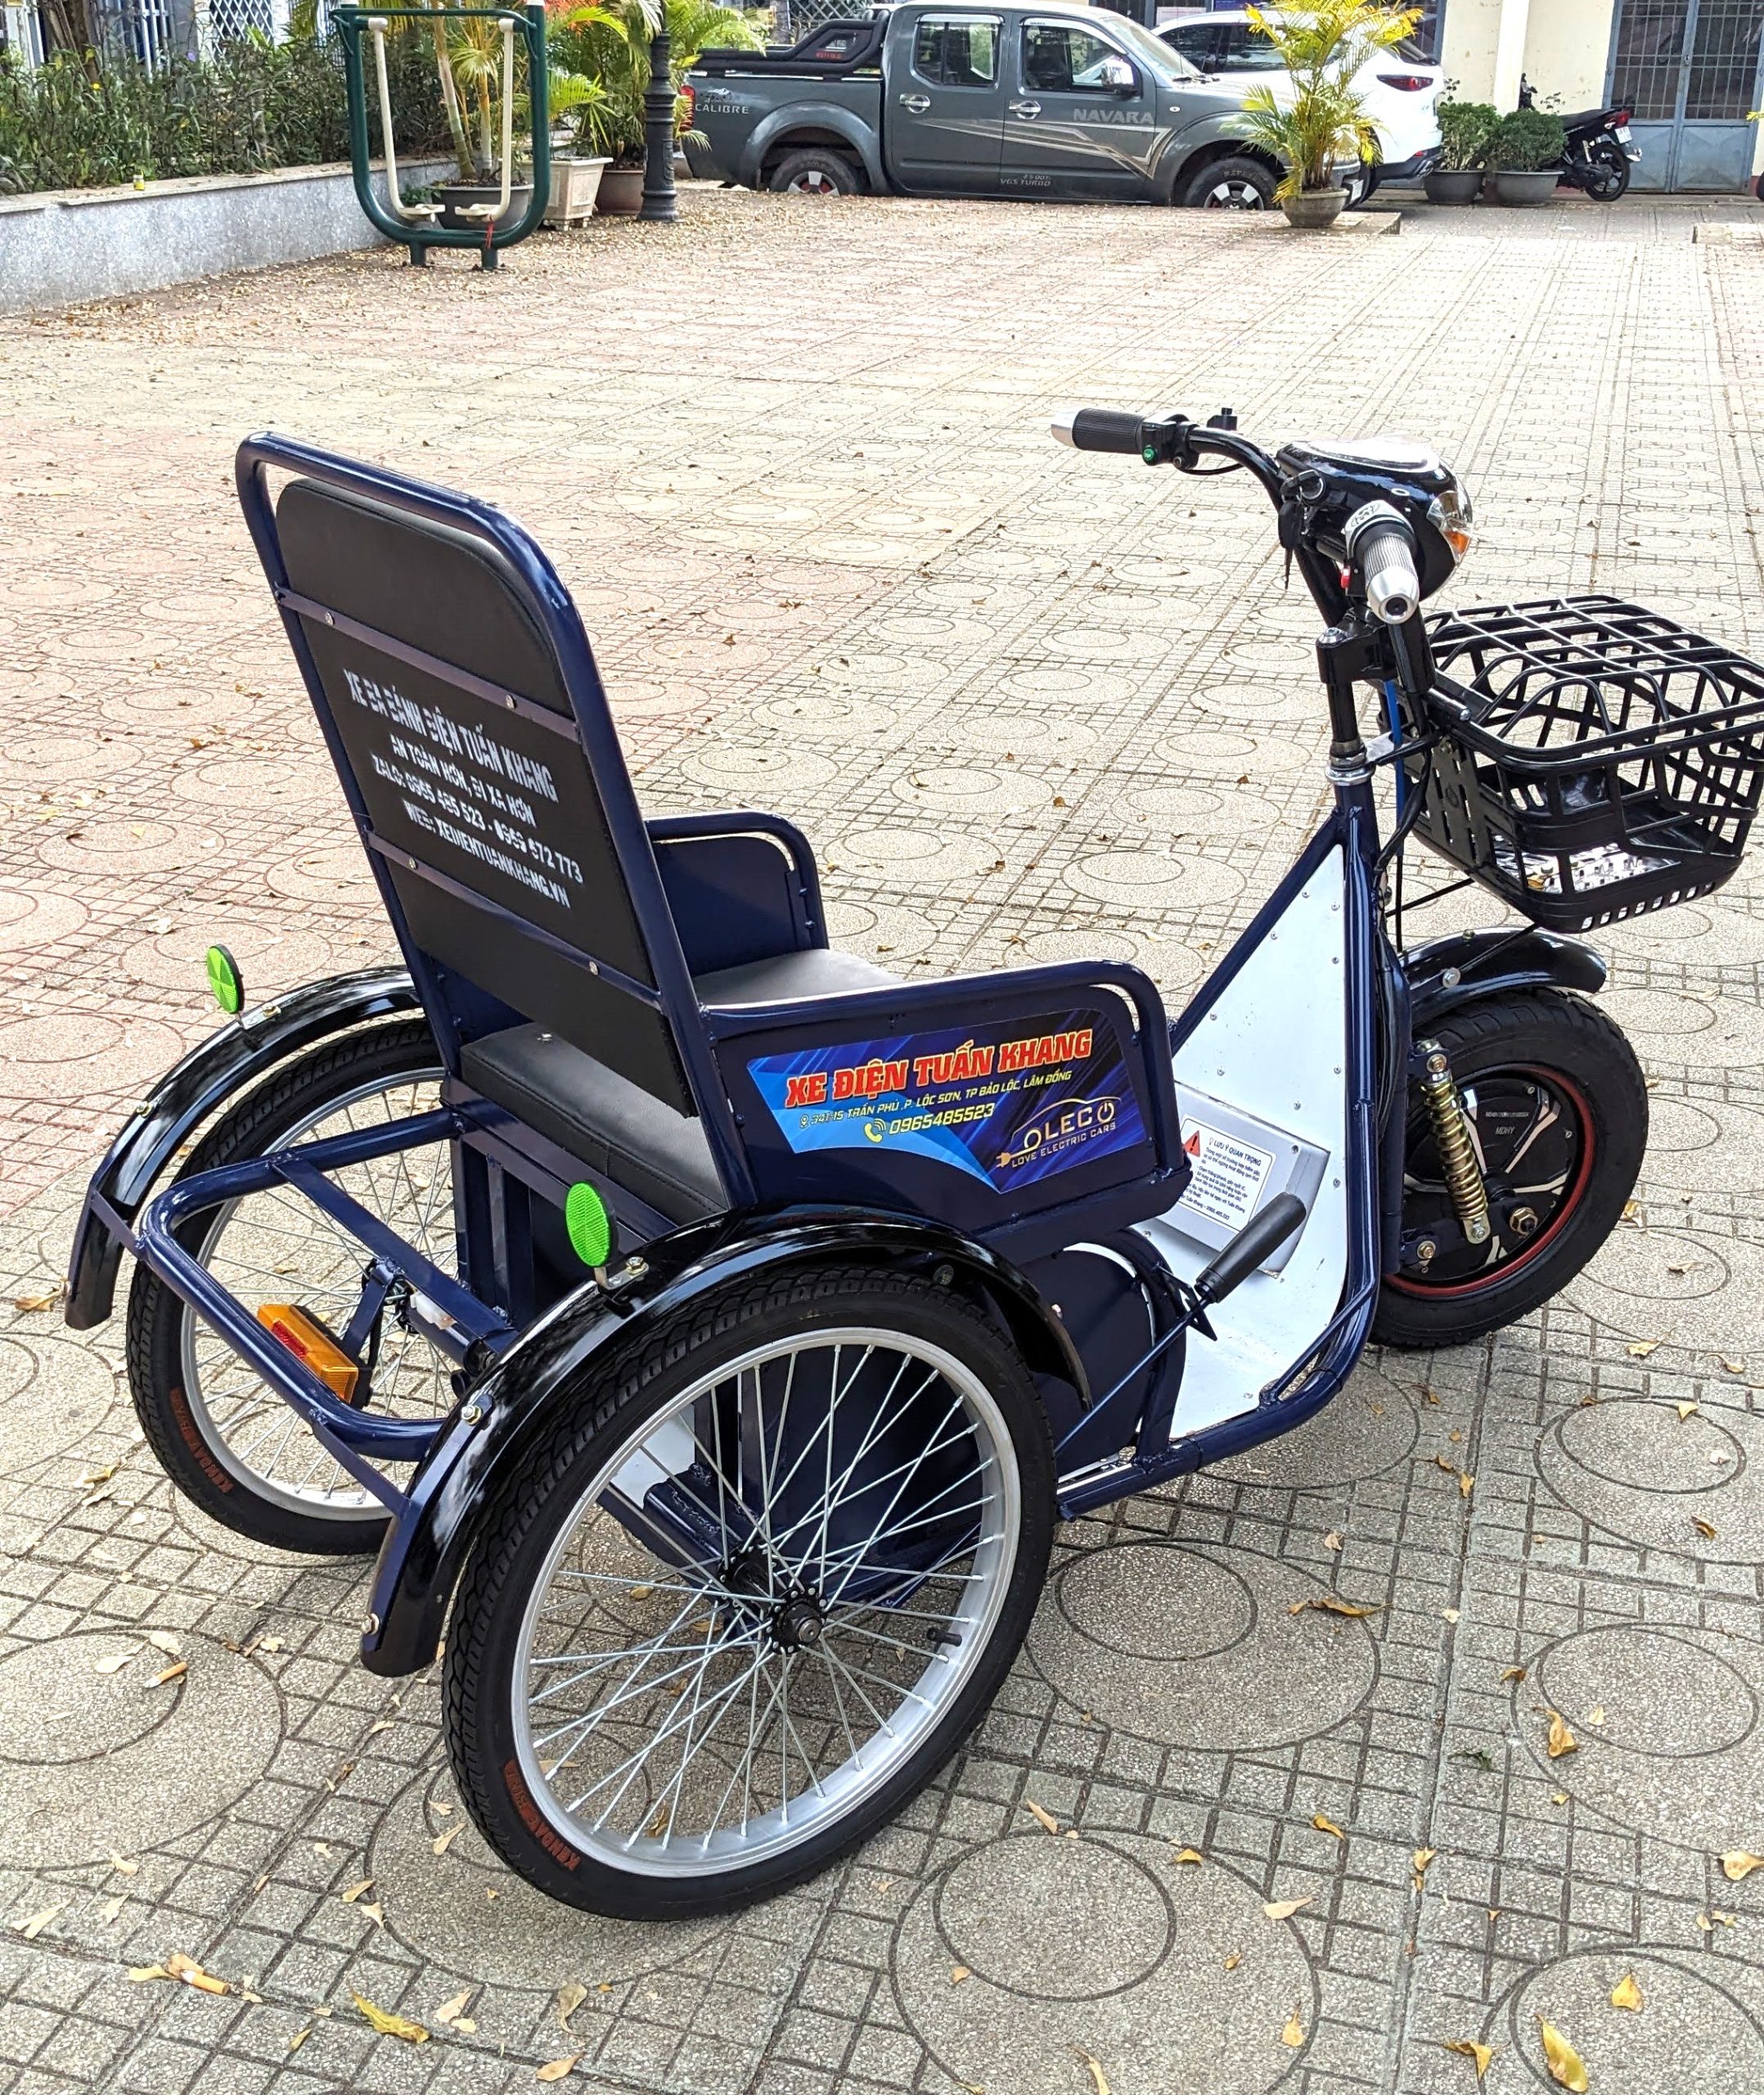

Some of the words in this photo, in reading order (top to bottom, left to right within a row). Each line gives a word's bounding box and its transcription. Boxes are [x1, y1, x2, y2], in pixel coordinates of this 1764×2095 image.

[695, 103, 749, 115] CALIBRE
[1073, 108, 1155, 124] NAVARA
[343, 668, 368, 707] XE
[457, 723, 505, 776] TUẤN
[499, 745, 560, 804] KHANG
[458, 799, 487, 831] 523
[553, 850, 584, 885] 773
[785, 1071, 828, 1109] XE
[832, 1058, 910, 1100] ĐIỆN
[913, 1038, 996, 1088] TUẤN
[997, 1028, 1094, 1073] KHANG
[965, 1088, 979, 1100] TP
[1023, 1073, 1046, 1088] LÂM
[889, 1102, 996, 1135] 0965485523
[1011, 1152, 1037, 1169] LOVE
[1039, 1133, 1087, 1158] ELECTRIC
[1089, 1121, 1116, 1138] CARS
[1229, 1147, 1244, 1159] QUAN
